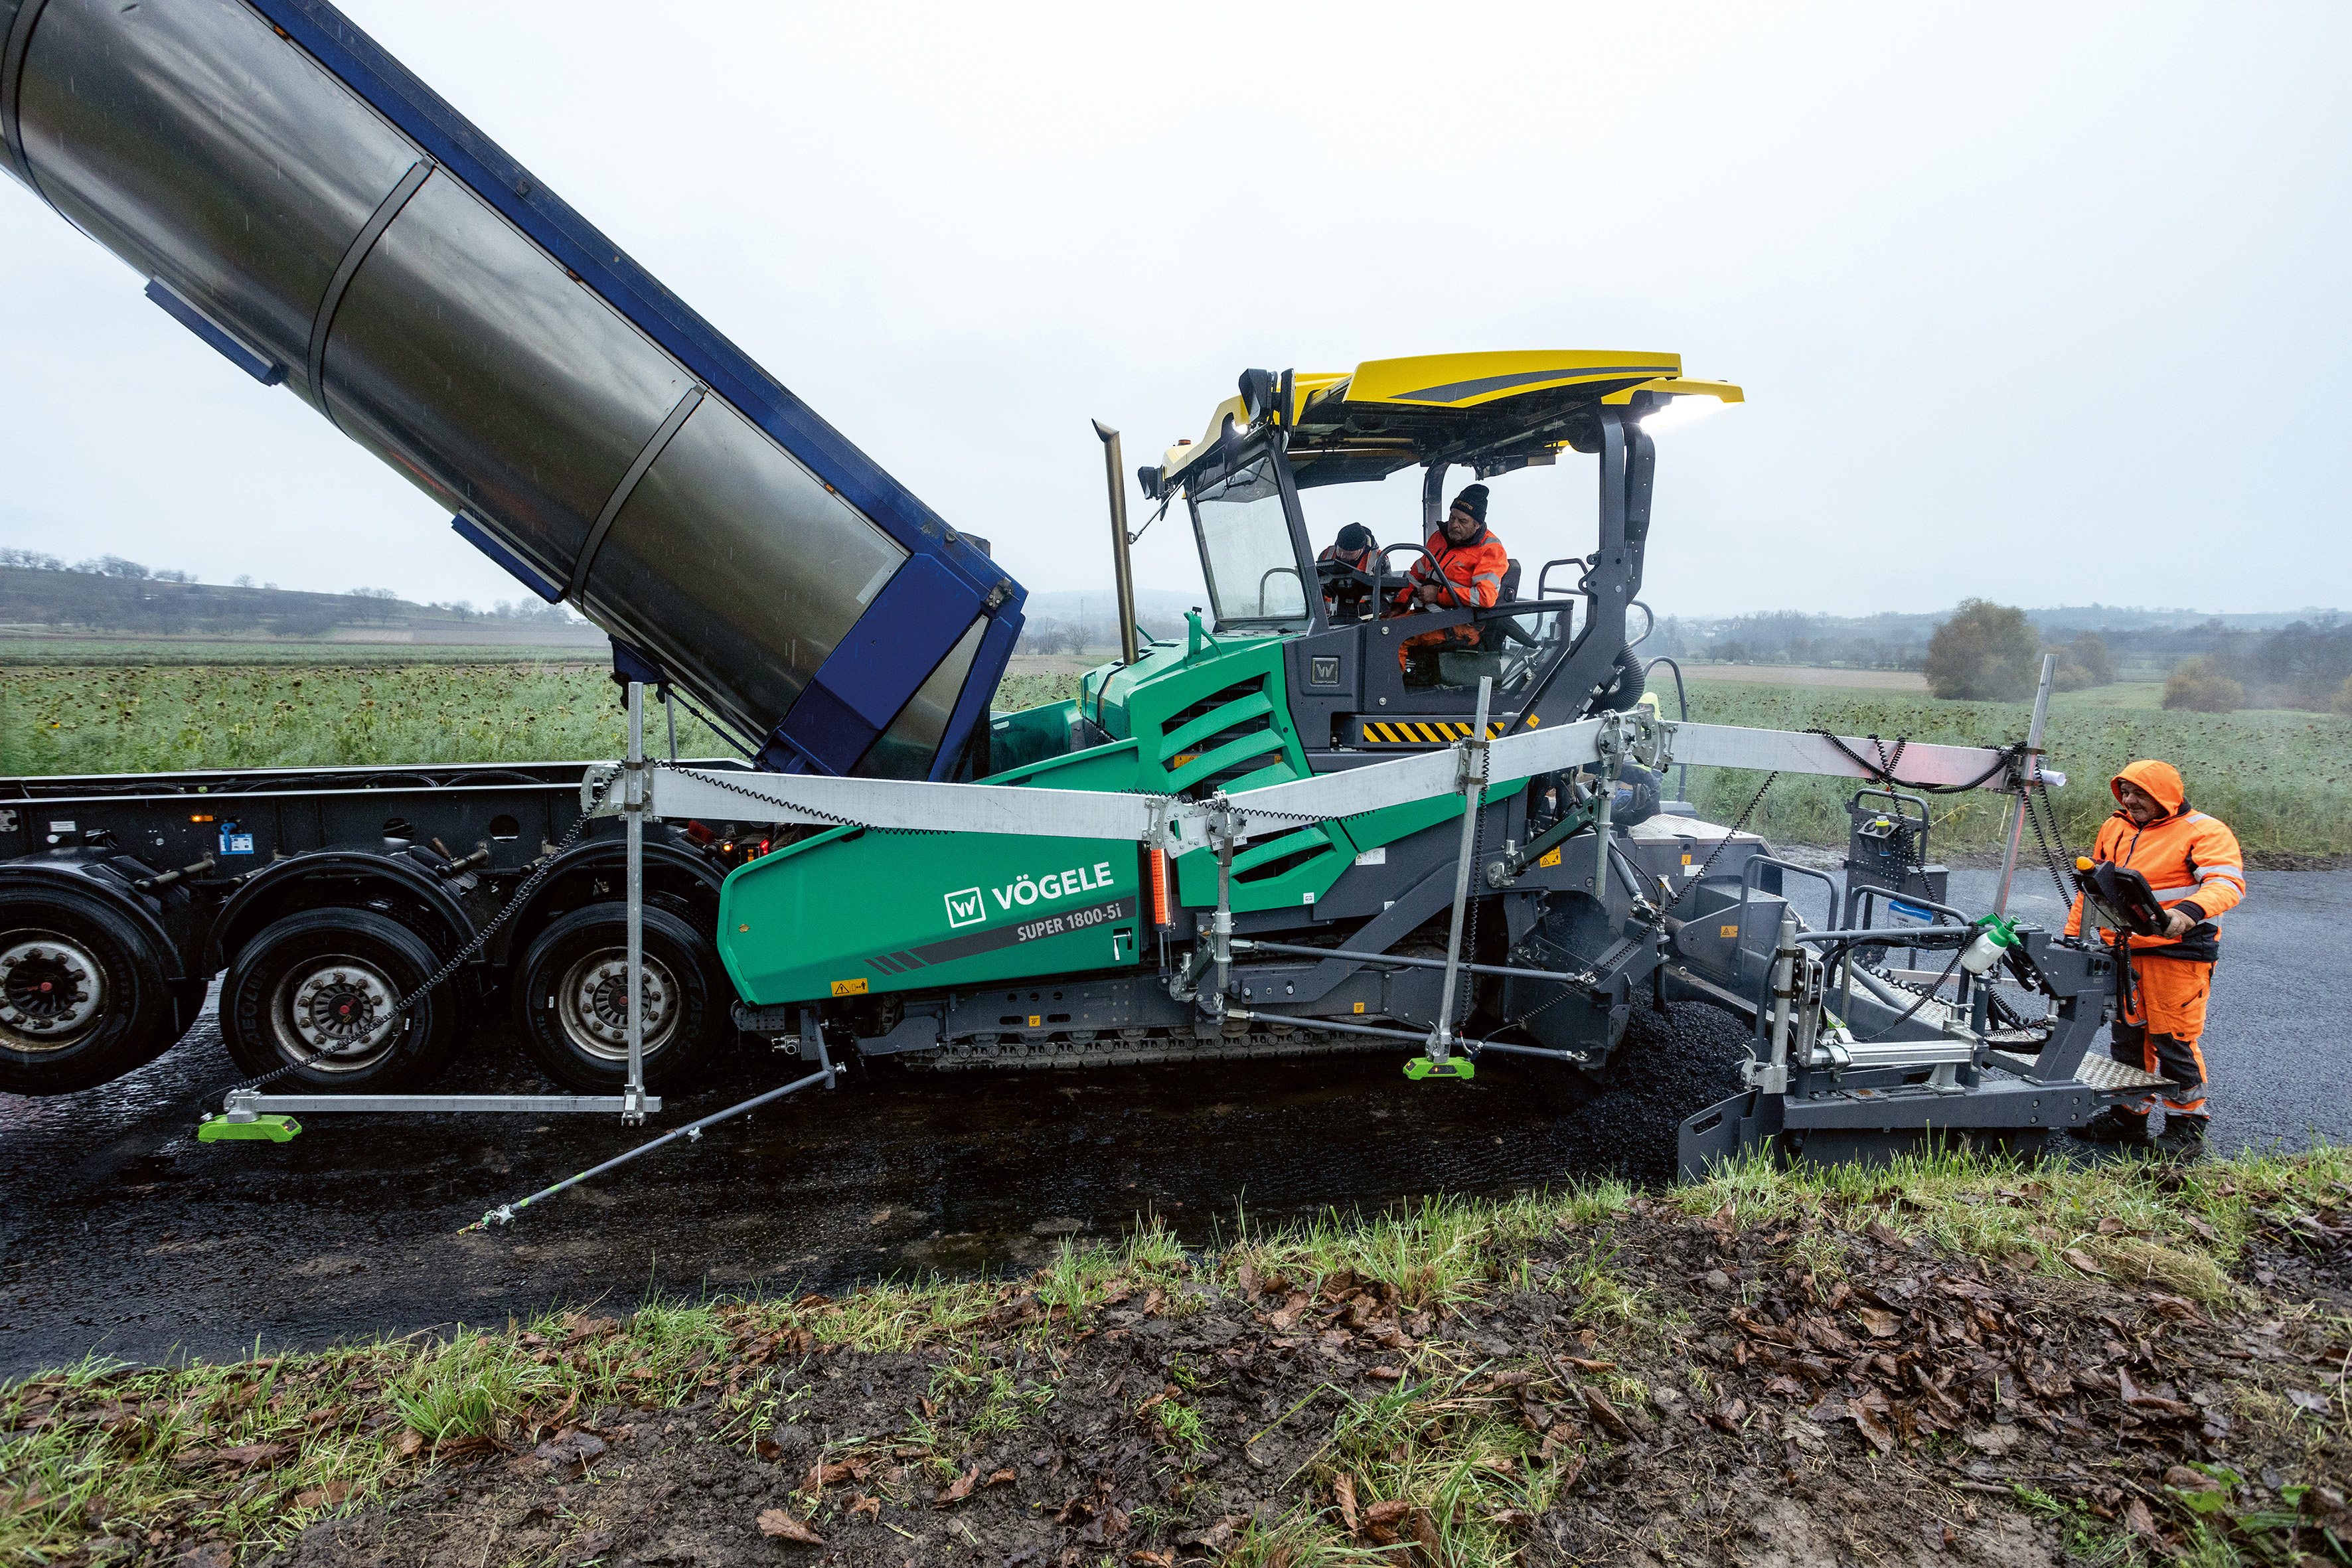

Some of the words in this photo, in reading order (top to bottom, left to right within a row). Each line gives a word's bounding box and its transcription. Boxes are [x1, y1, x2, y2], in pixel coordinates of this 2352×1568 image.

[991, 862, 1114, 910] VÖGELE
[1016, 917, 1064, 941] SUPER
[1066, 903, 1122, 929] 1800-5i
